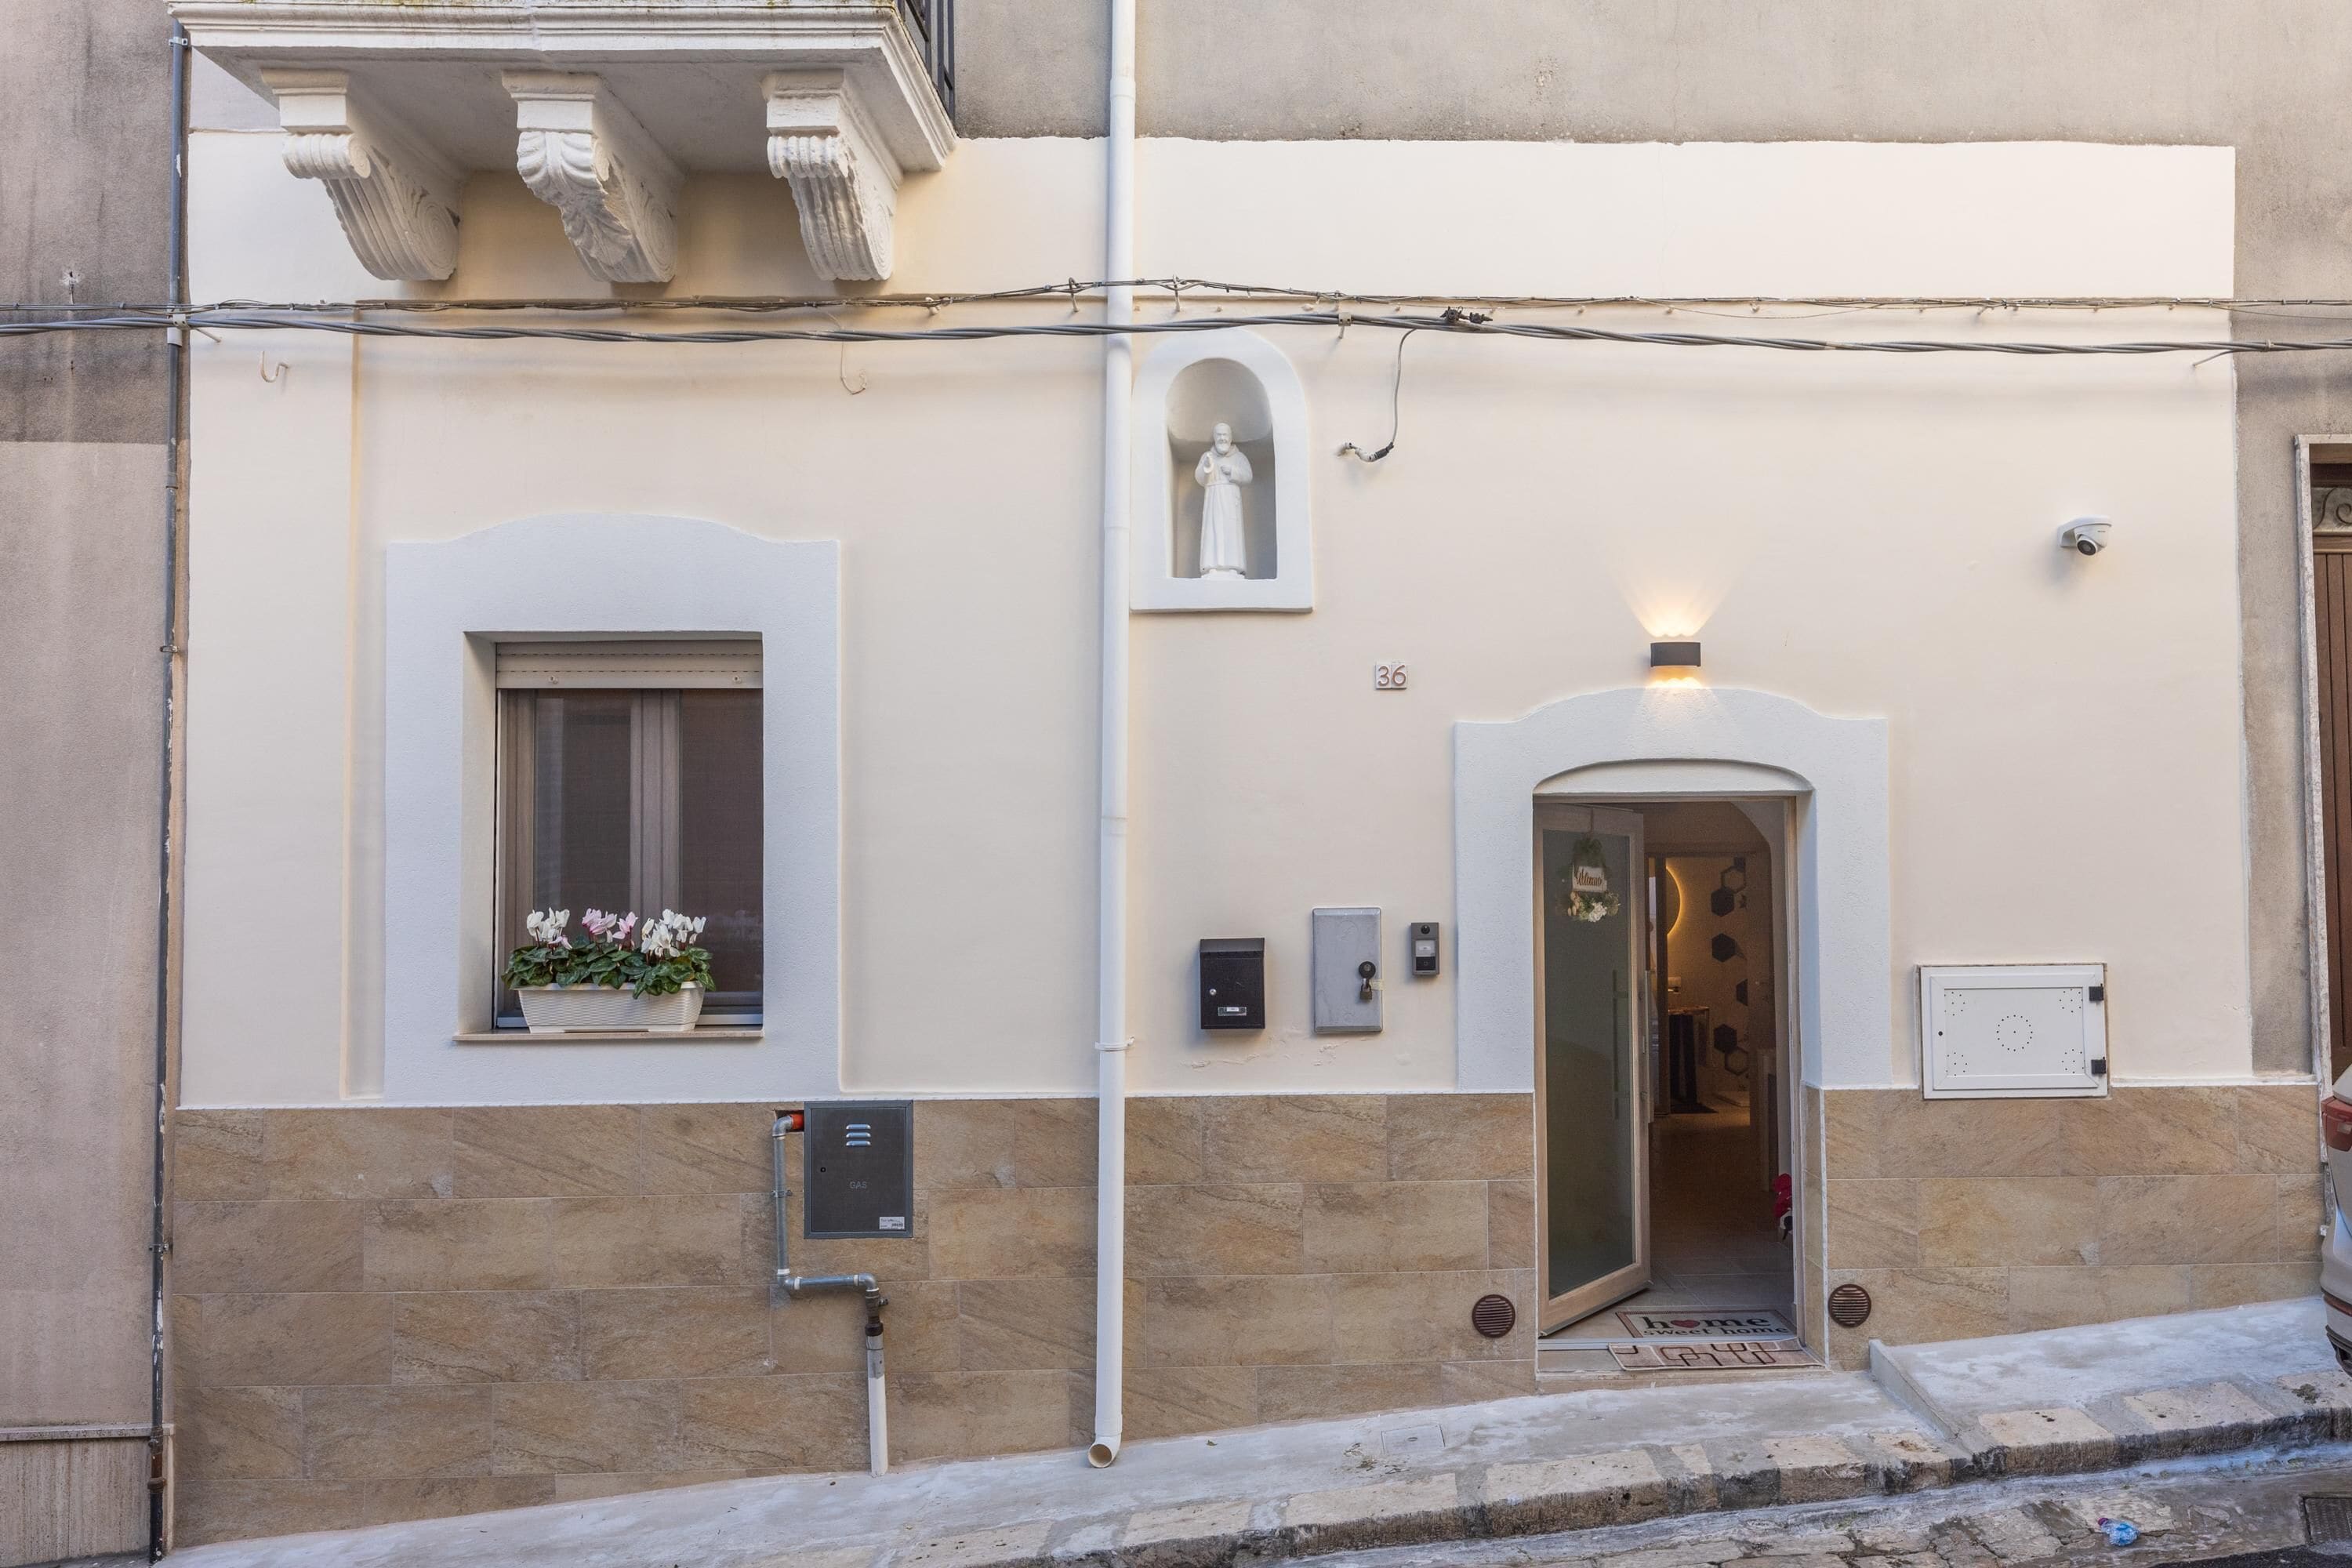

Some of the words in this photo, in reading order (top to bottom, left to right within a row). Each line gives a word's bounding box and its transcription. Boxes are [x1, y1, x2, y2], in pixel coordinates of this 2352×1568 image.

[1377, 664, 1406, 687] 36
[849, 1181, 867, 1189] GAS
[1720, 1327, 1788, 1335] home
